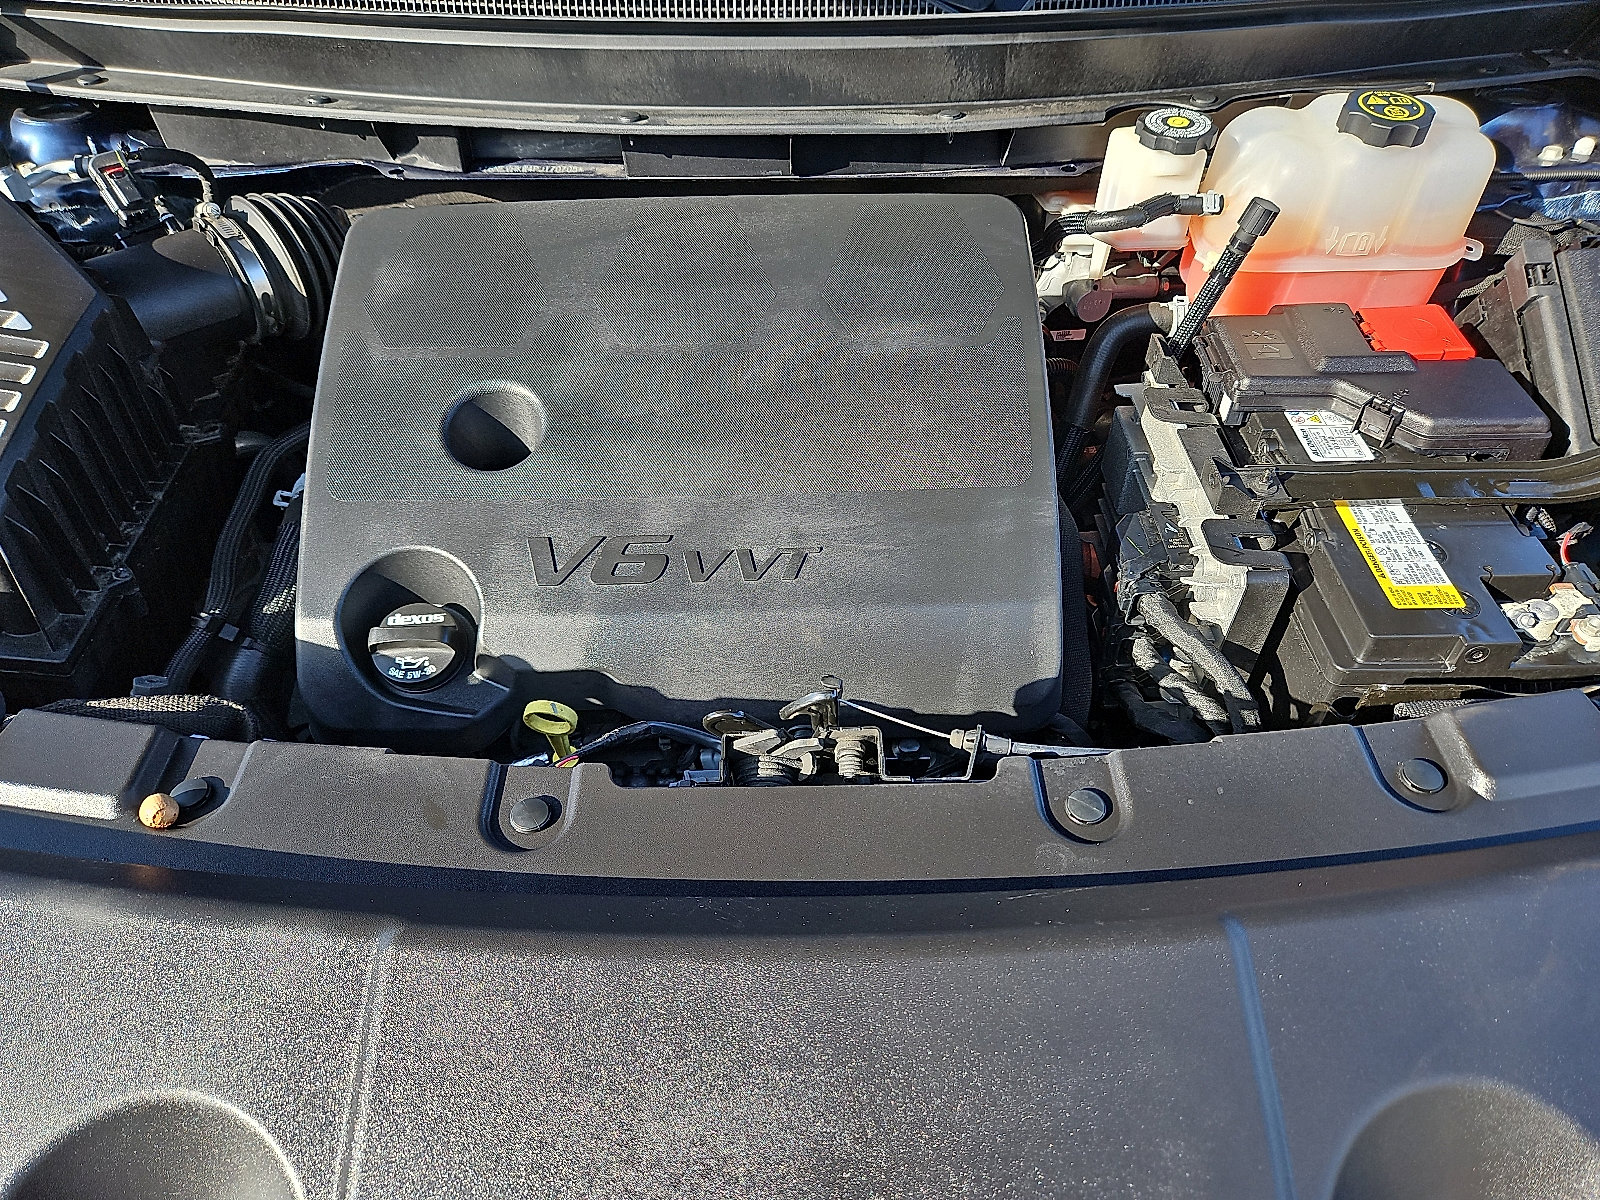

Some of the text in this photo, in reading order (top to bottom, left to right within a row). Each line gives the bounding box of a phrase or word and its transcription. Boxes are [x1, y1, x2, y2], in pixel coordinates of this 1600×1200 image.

[527, 535, 823, 586] V6 VVT
[387, 613, 446, 626] dexos
[388, 667, 405, 679] SAE
